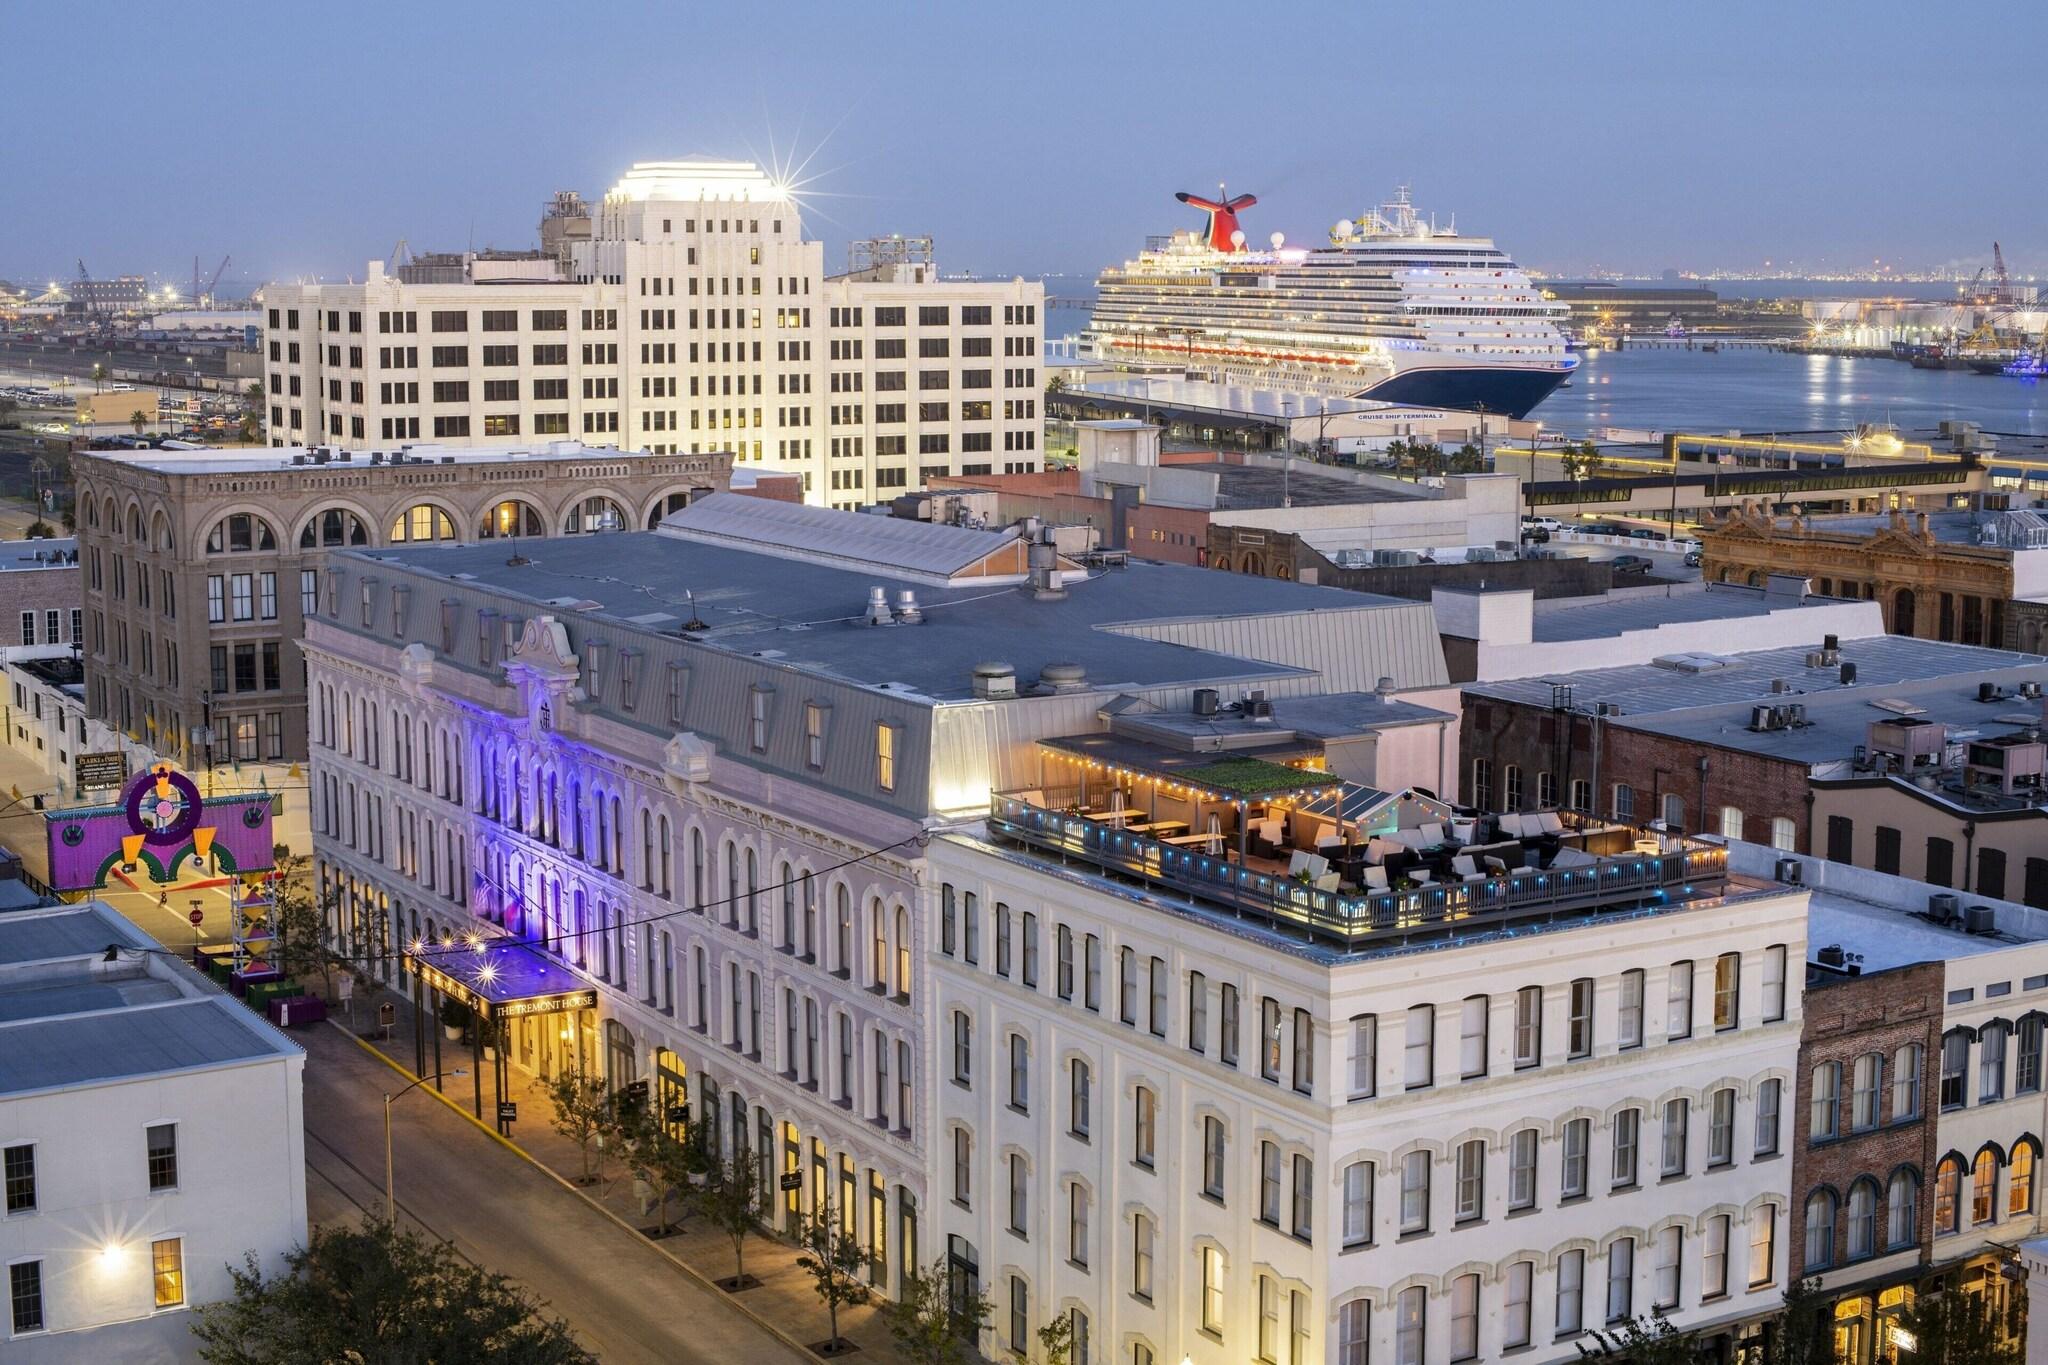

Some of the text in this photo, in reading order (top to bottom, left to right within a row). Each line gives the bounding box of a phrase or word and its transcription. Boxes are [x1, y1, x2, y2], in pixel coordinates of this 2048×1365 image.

[496, 996, 592, 1016] THE TREMONT HOUSE
